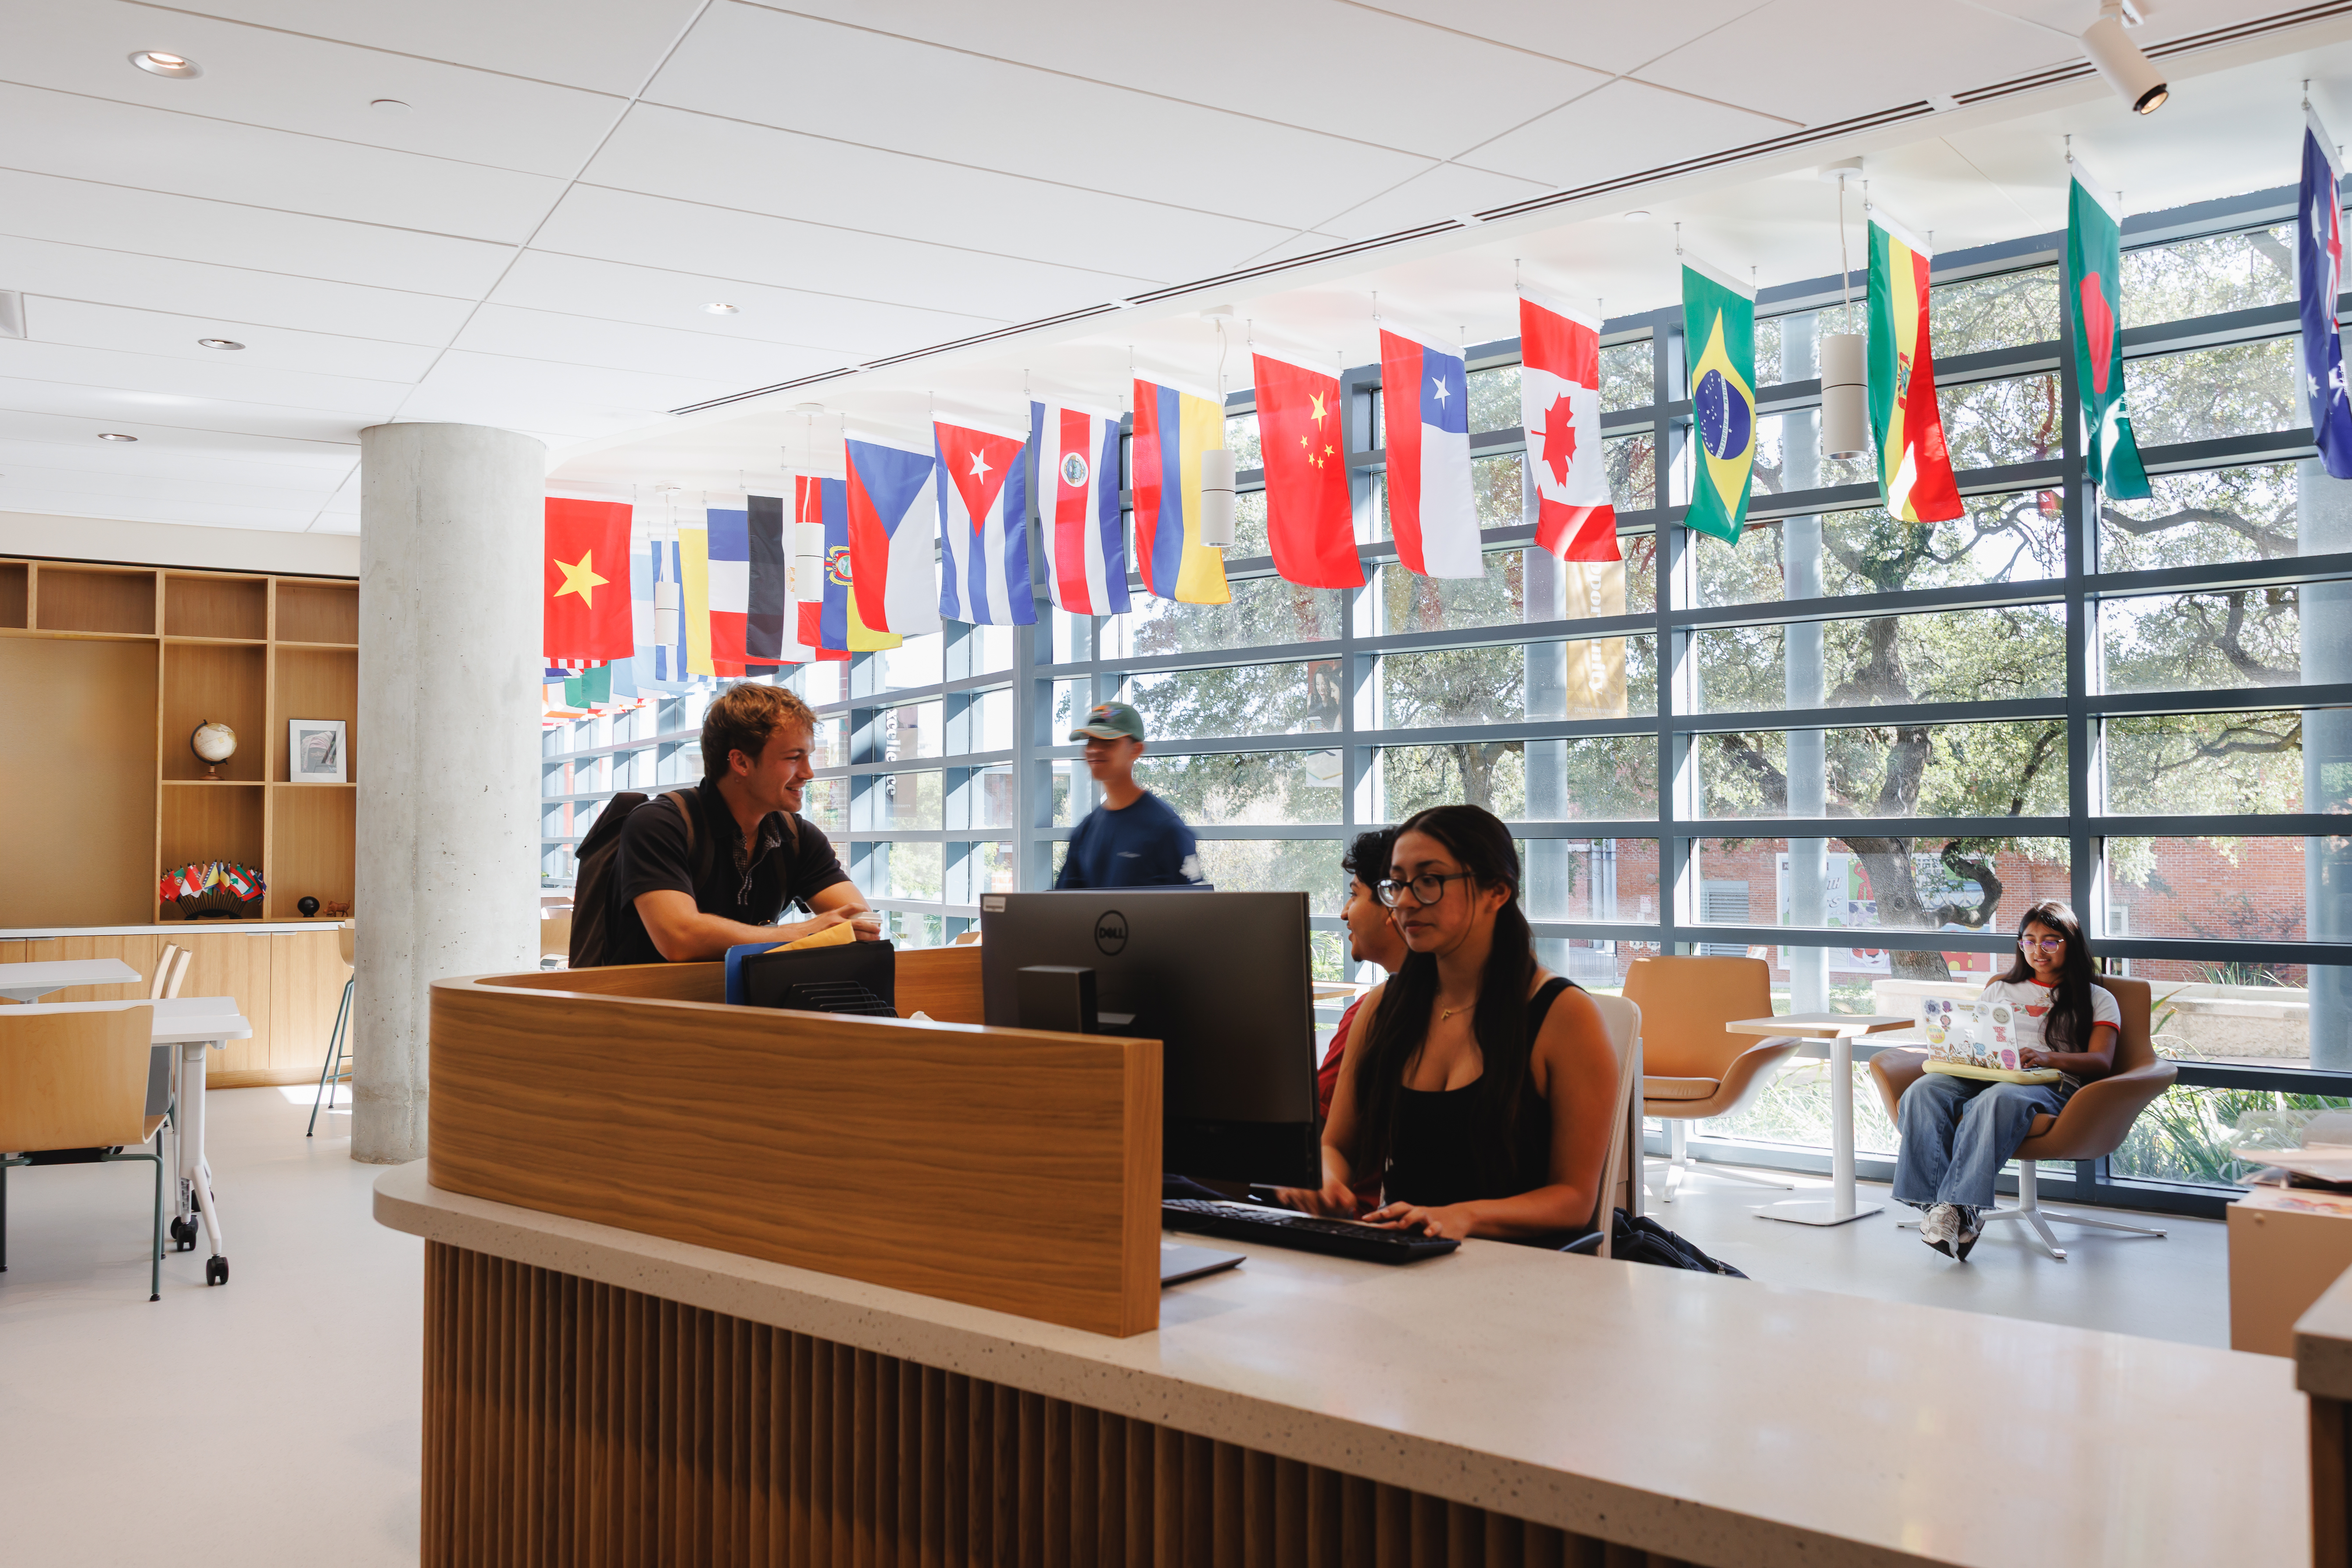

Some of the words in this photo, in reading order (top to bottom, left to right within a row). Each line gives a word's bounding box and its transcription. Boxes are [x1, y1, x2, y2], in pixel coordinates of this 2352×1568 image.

[1717, 418, 1728, 457] PROGRESSO
[886, 708, 901, 796] xcellece
[1099, 926, 1125, 939] DELL
